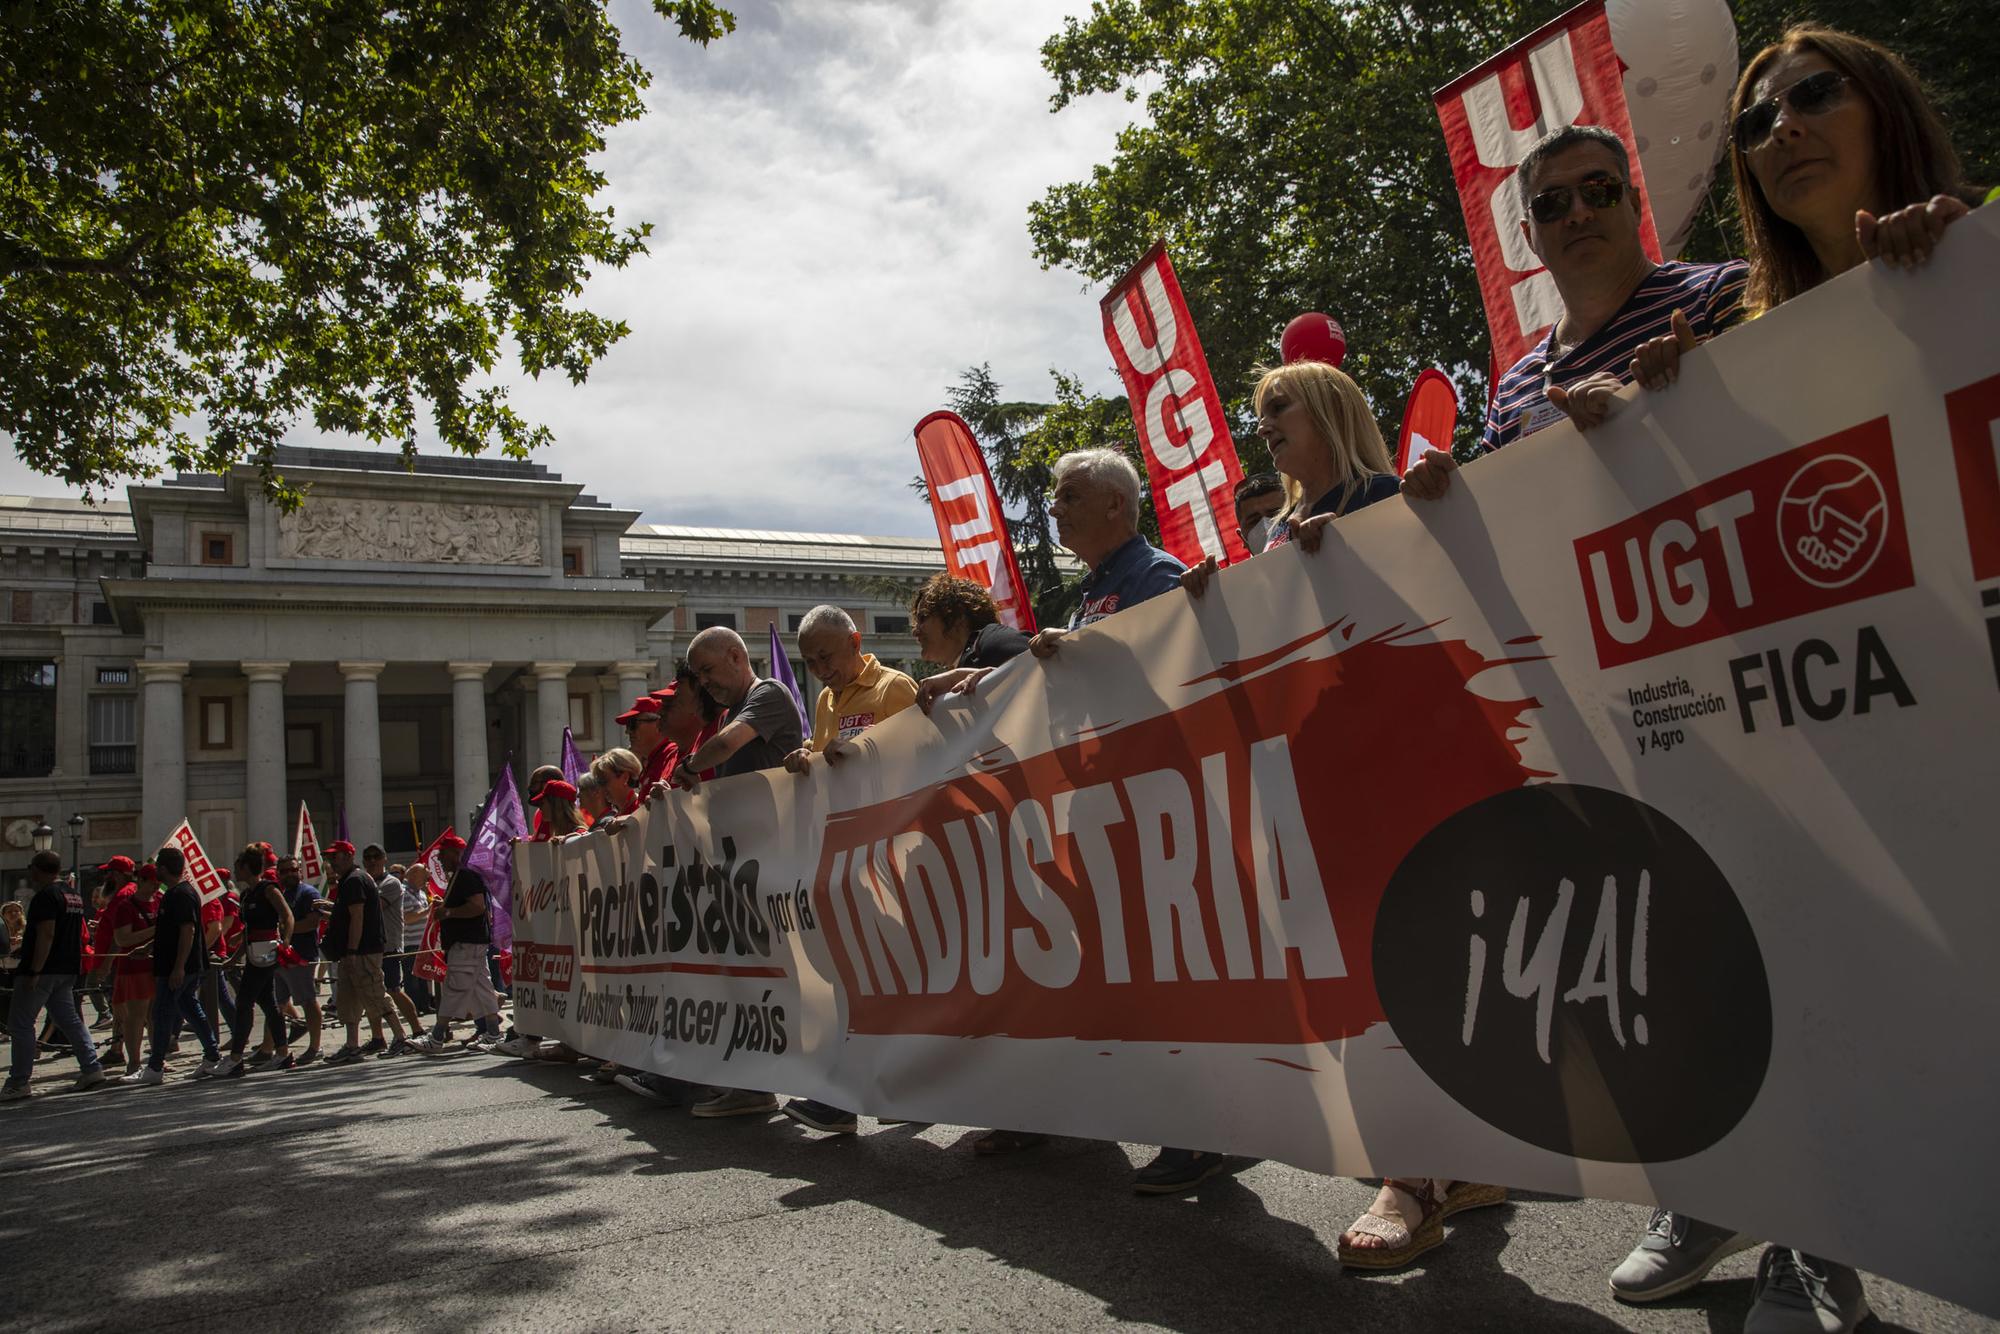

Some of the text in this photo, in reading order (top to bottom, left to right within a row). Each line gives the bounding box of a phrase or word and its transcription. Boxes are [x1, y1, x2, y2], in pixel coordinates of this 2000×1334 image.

[1111, 261, 1228, 563] UGT
[1589, 489, 1755, 644] UGT
[1628, 676, 1695, 707] Industria,
[1632, 694, 1727, 728] Construcción
[1728, 625, 1918, 734] FICA
[839, 715, 861, 729] UGT
[1636, 729, 1684, 756] y Agro
[828, 734, 1348, 997] INDUSTRIA
[516, 987, 537, 1009] FICA
[1462, 868, 1651, 1064] ¡YA!
[722, 990, 788, 1062] país
